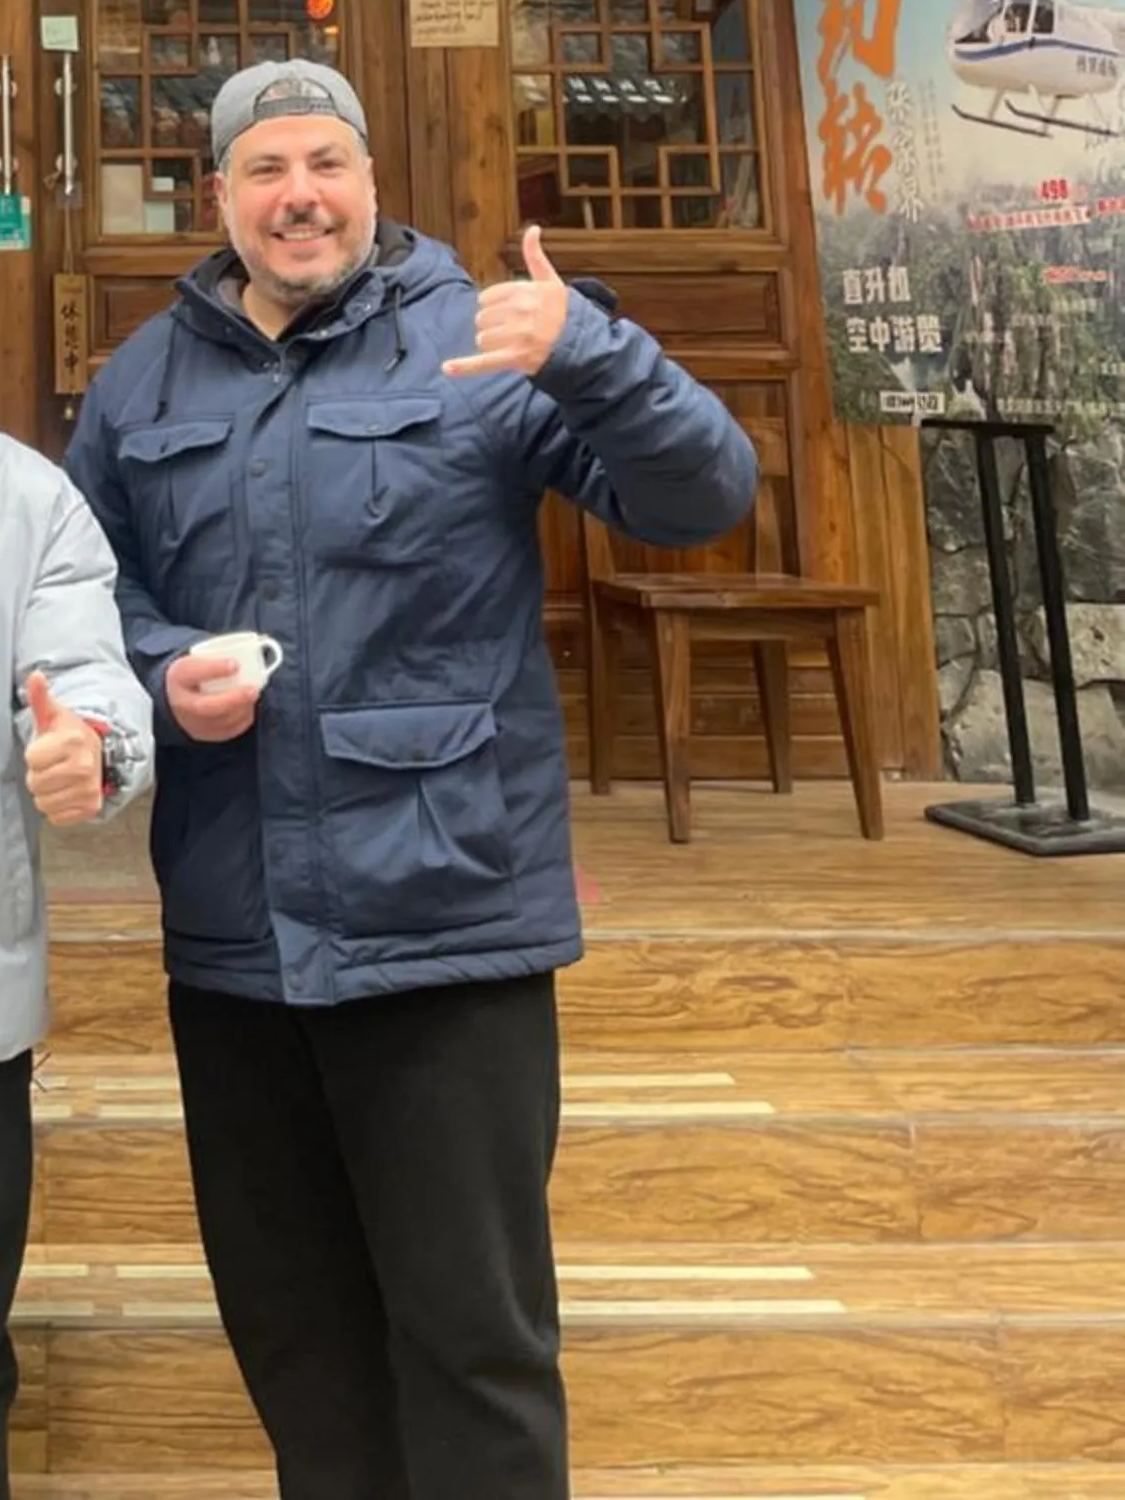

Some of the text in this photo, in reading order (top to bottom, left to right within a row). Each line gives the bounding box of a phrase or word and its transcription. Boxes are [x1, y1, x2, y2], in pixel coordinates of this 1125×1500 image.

[842, 266, 911, 304] 直升机
[846, 314, 943, 352] 空中游览
